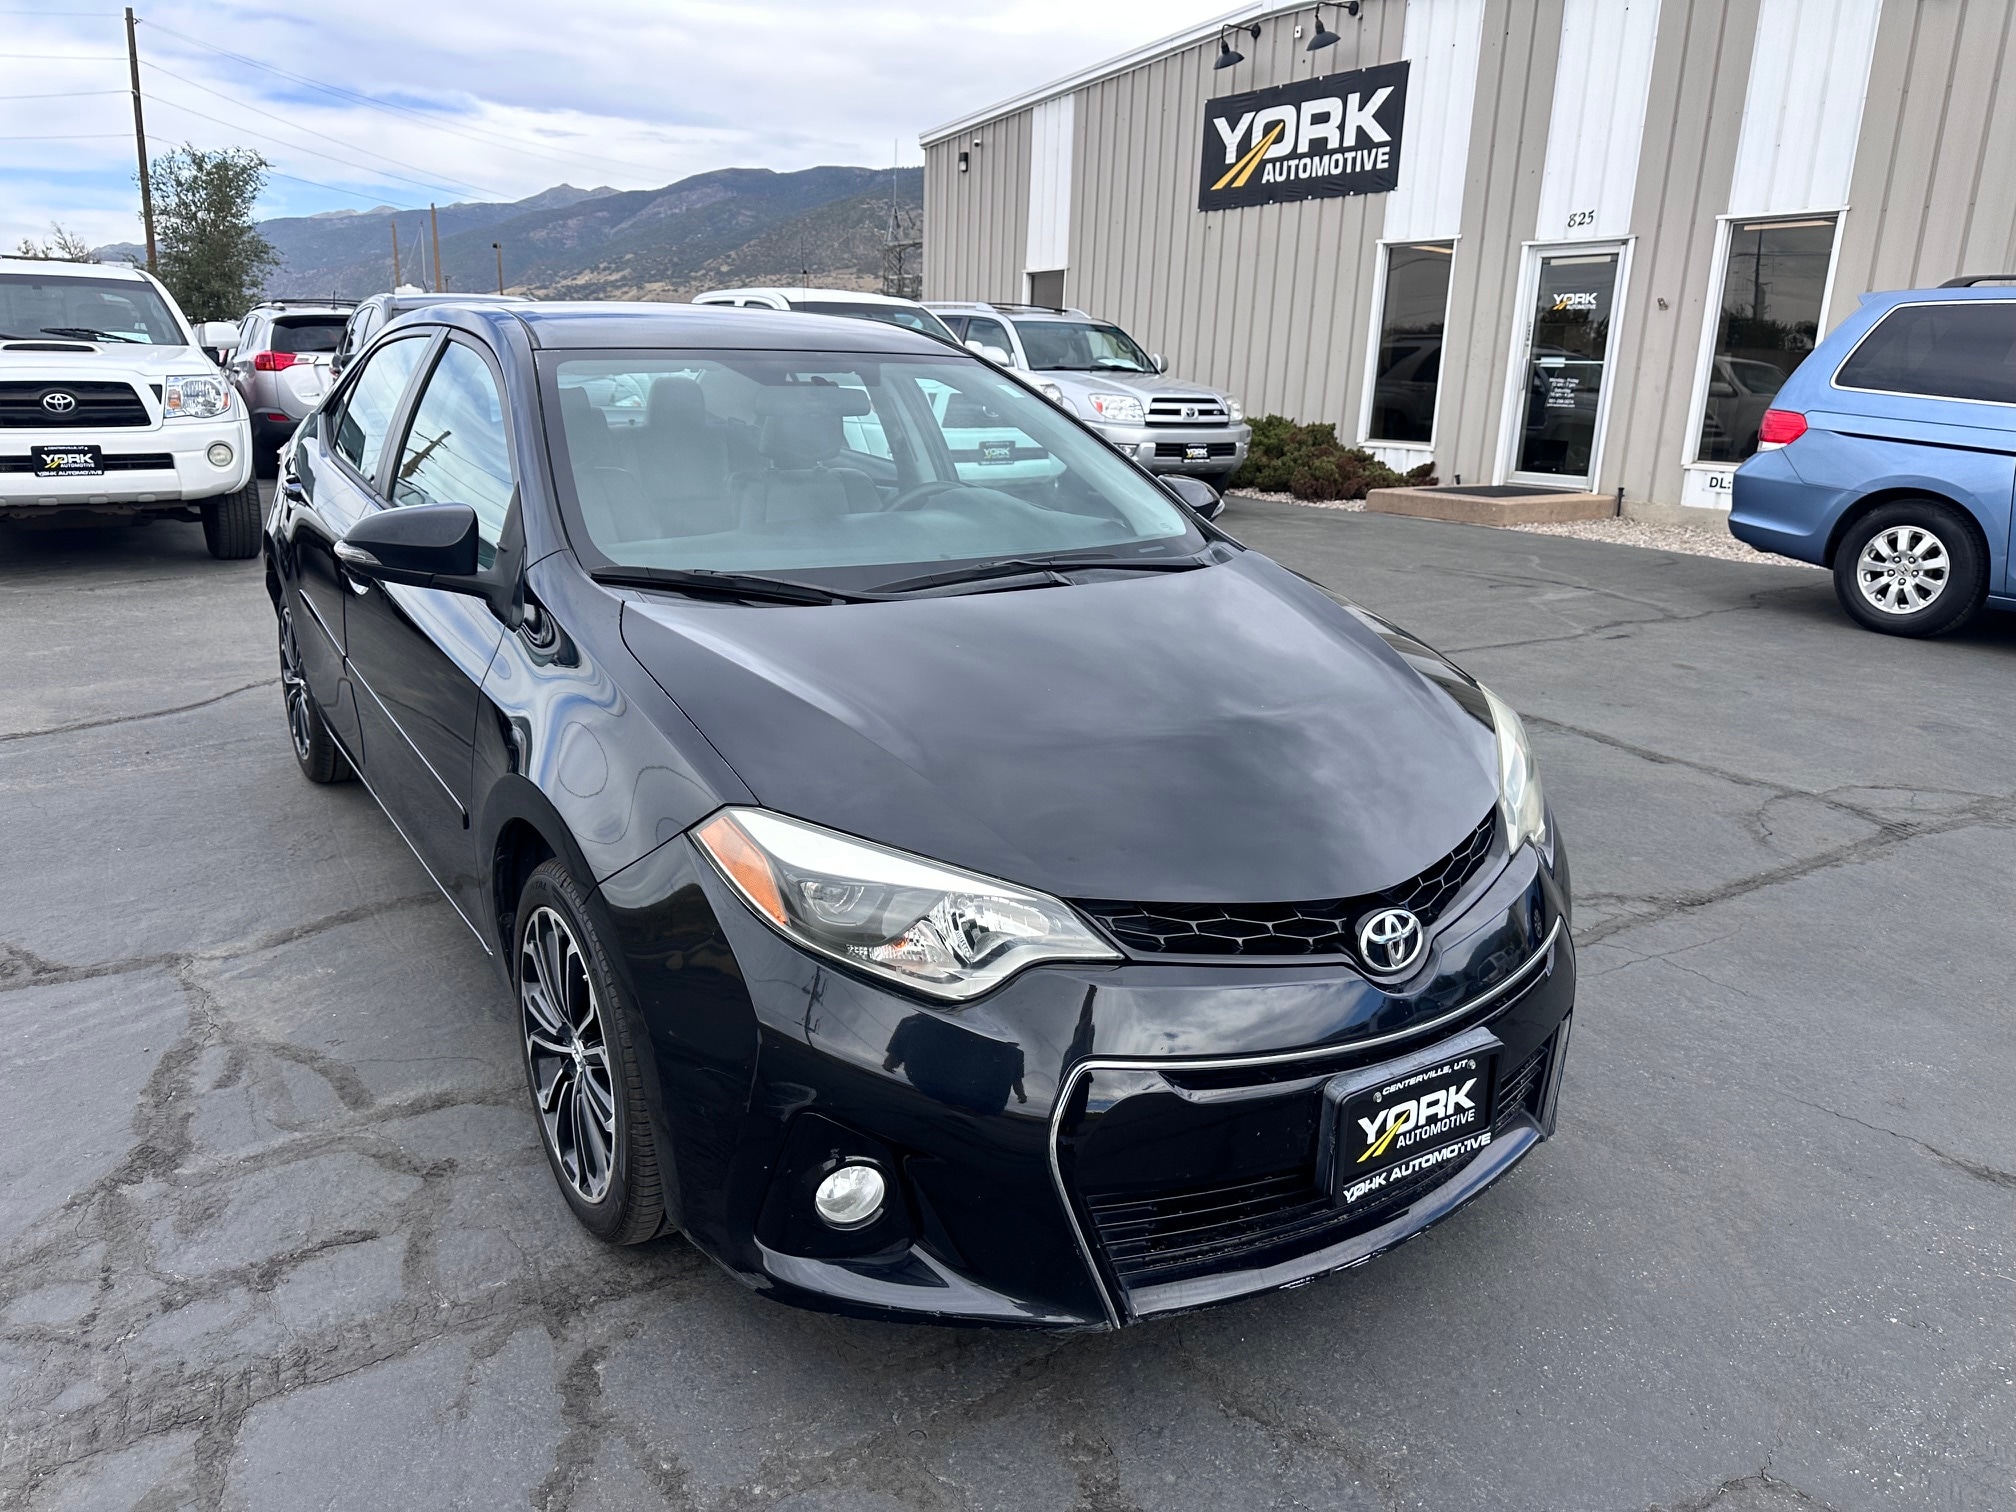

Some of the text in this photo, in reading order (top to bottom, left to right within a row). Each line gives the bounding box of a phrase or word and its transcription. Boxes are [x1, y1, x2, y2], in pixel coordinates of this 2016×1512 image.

[1213, 86, 1395, 165] YORK
[1262, 146, 1391, 184] AUTOMOTIVE
[1567, 209, 1595, 228] 825
[1553, 292, 1598, 305] YORK
[40, 453, 94, 464] YORK
[983, 447, 1010, 456] YORK
[1709, 476, 1732, 490] DL:
[1382, 1059, 1468, 1096] CENTERVILLE, UT
[1357, 1077, 1478, 1145] YORK
[1396, 1109, 1476, 1149] AUTOMOTIVE
[1342, 1132, 1492, 1204] YORK AUTOMOTIVE
